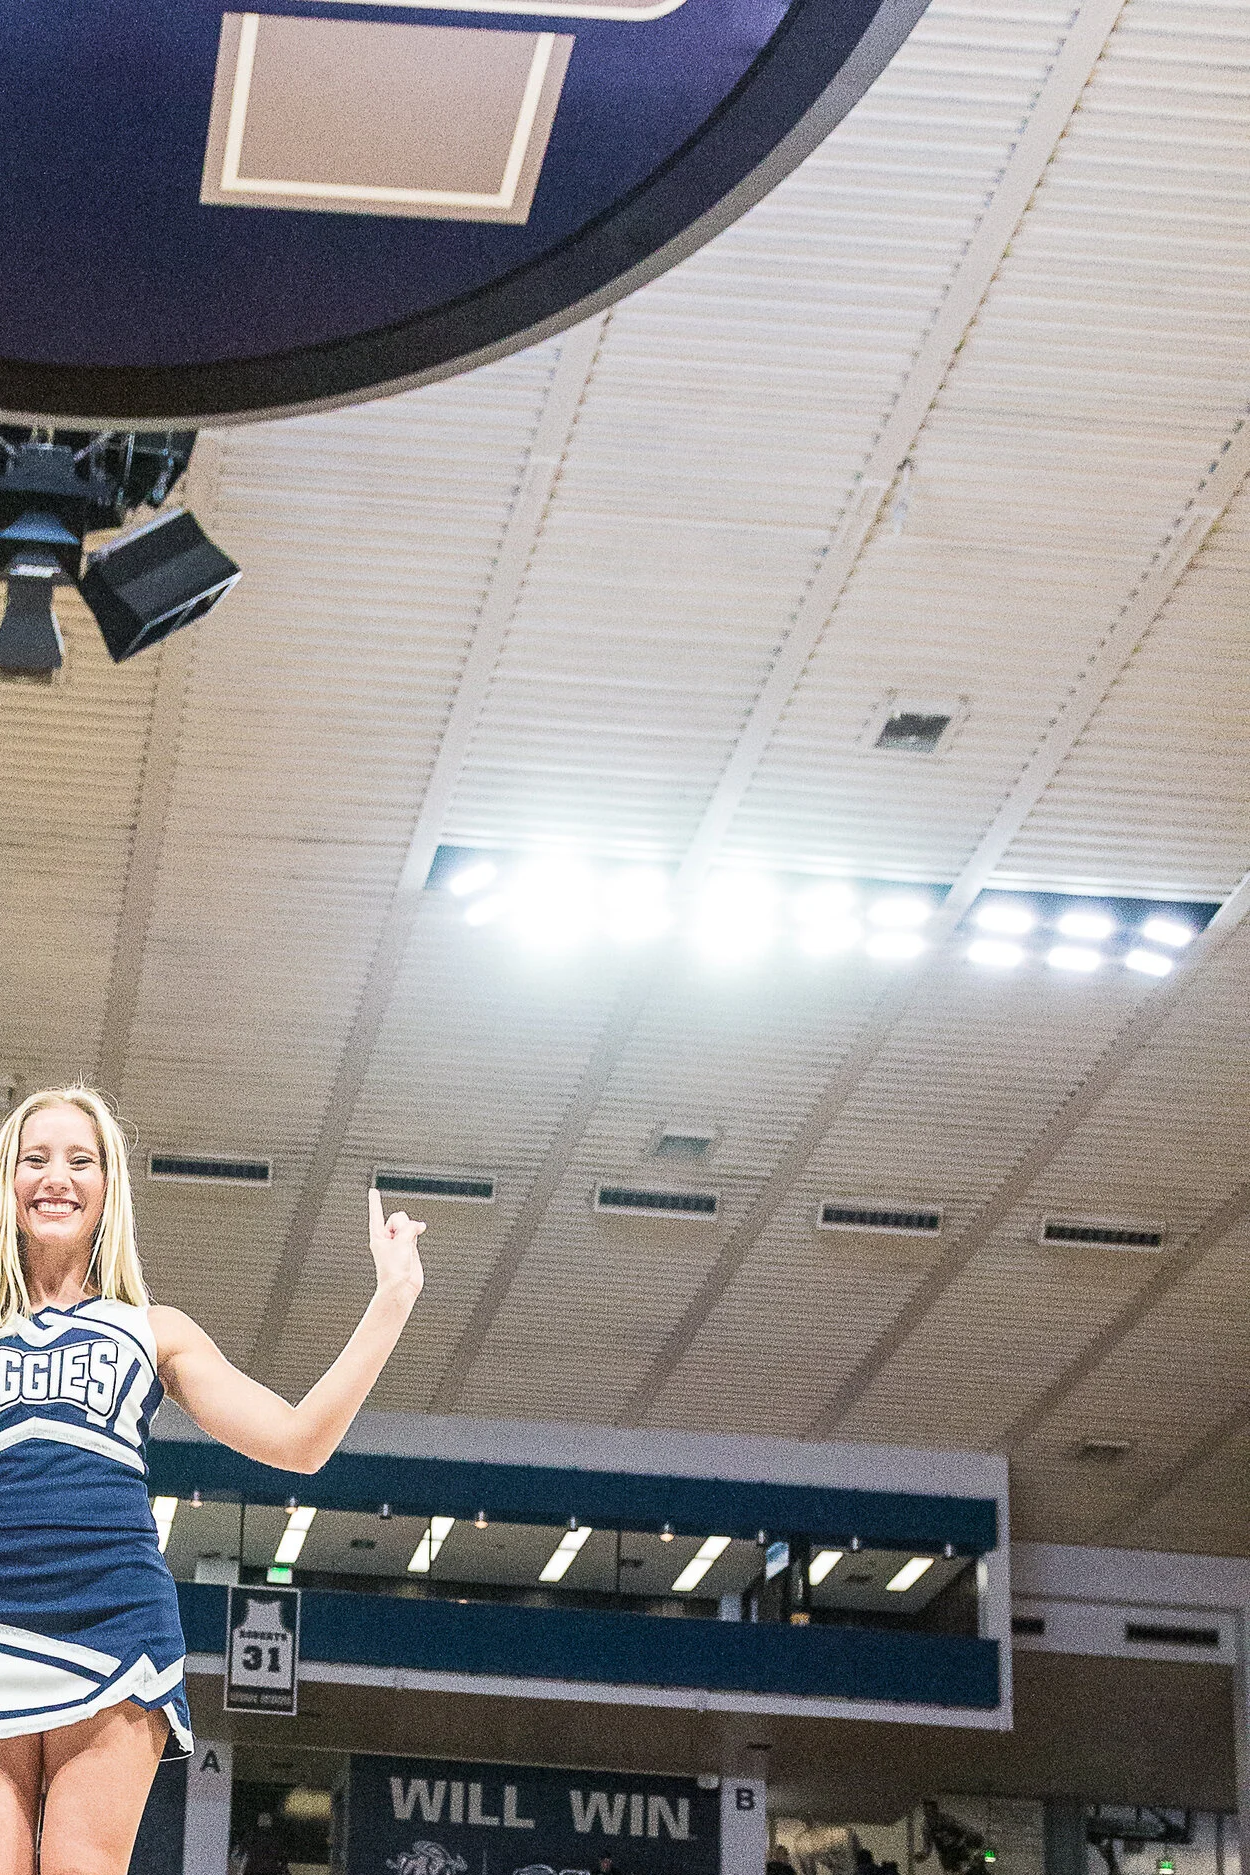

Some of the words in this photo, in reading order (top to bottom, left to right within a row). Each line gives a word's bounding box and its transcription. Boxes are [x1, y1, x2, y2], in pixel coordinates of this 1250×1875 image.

[242, 1645, 281, 1673] 31
[200, 1749, 221, 1774] A
[390, 1776, 536, 1830] WILL
[569, 1789, 690, 1841] WIN
[736, 1789, 756, 1812] B
